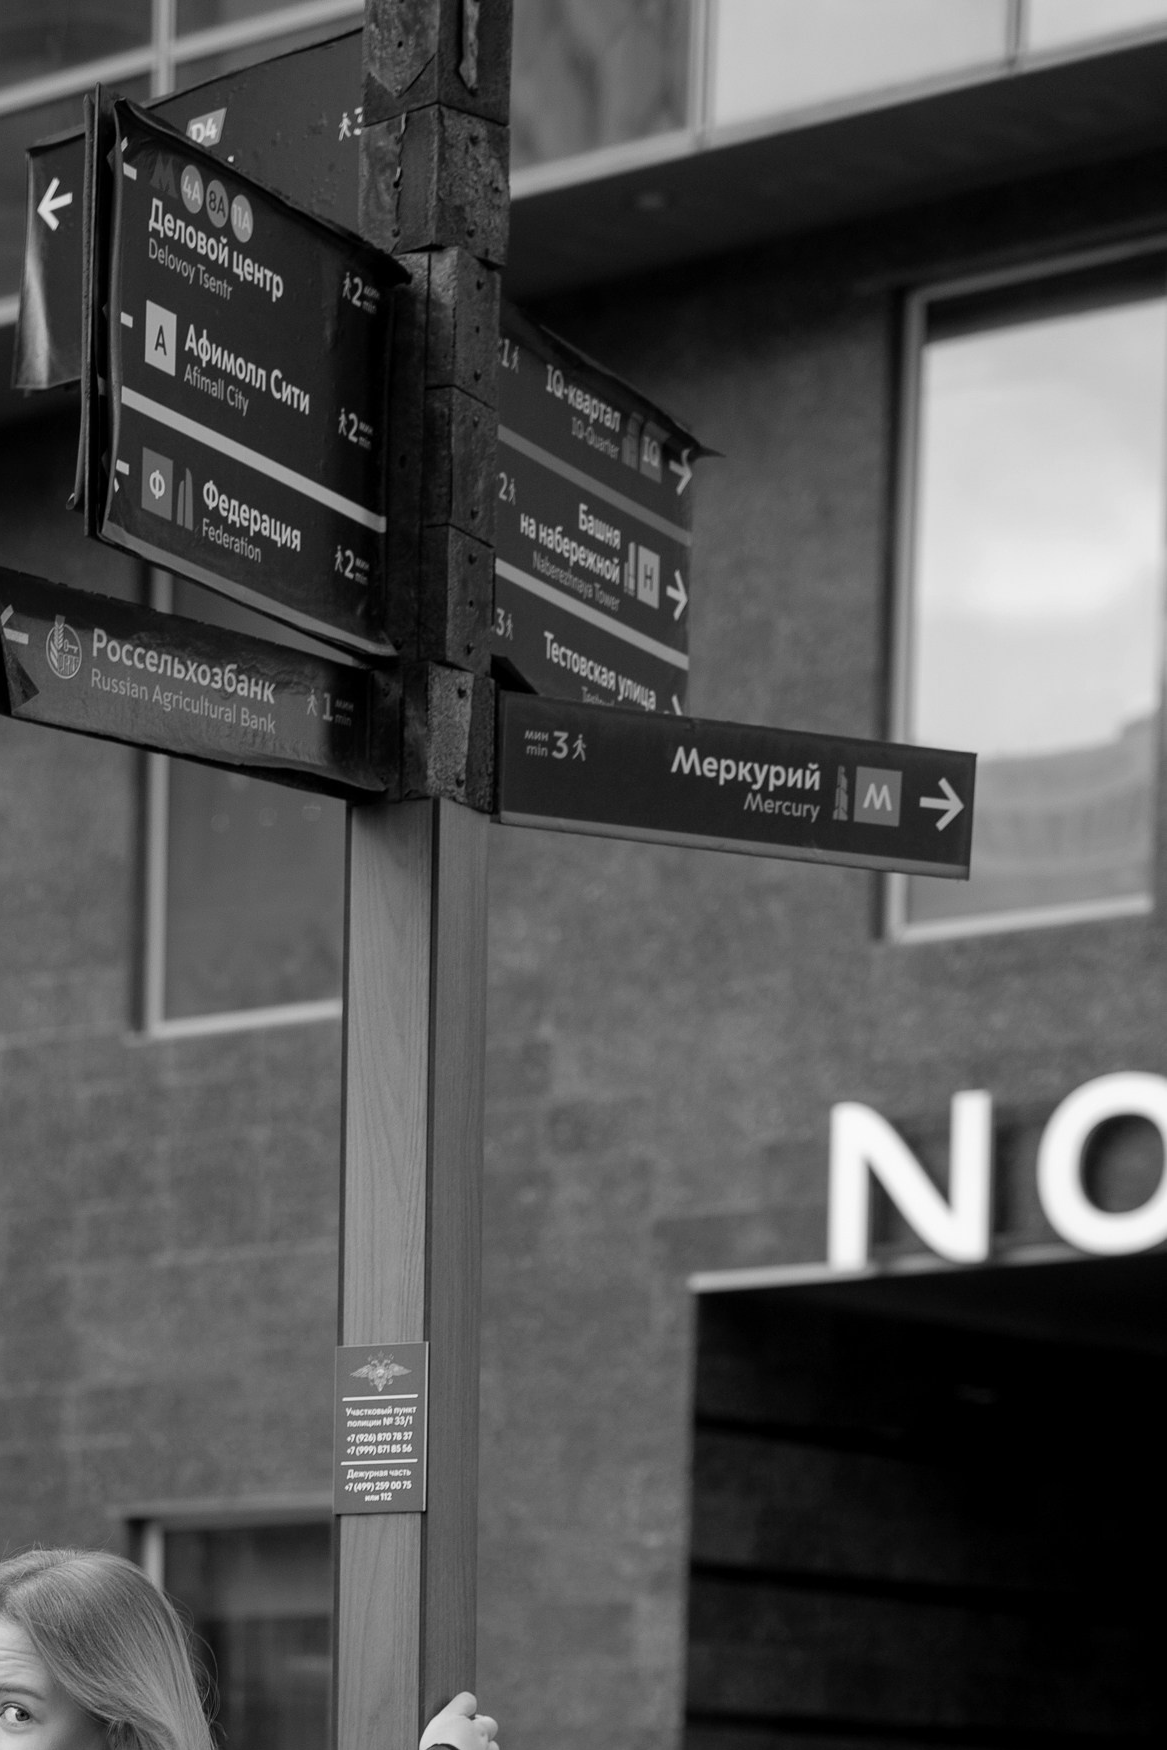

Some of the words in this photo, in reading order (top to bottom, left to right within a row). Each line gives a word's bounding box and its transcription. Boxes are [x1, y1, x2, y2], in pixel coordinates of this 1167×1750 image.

[148, 197, 229, 268] Деловой
[232, 251, 284, 302] центр
[148, 237, 196, 284] Delovoy
[197, 264, 233, 300] Tsentr
[352, 276, 363, 307] 2
[184, 323, 267, 392] Афимолл
[270, 368, 310, 416] Сити
[184, 363, 224, 401] Afimall
[226, 385, 249, 417] City
[545, 363, 621, 432] IQ-квартал
[348, 412, 358, 443] 2
[571, 416, 620, 460] IQ-Quarter
[642, 435, 659, 467] IQ
[149, 469, 165, 499] Ф
[499, 472, 508, 501] 2
[202, 480, 301, 552] Федерация
[578, 502, 621, 550] Башня
[202, 518, 262, 563] Federation
[520, 513, 536, 540] на
[538, 523, 620, 585] набережной
[344, 549, 355, 580] 2
[534, 551, 594, 599] Naberezhnaya
[594, 582, 620, 611] Tower
[496, 607, 505, 636] 3
[92, 627, 276, 704] Россельхозбанк
[544, 630, 616, 691] Тестовская
[617, 674, 656, 711] улица
[91, 667, 148, 701] Russian
[152, 684, 236, 724] Agricultural
[241, 707, 276, 734] Bank
[323, 692, 334, 722] 1
[524, 730, 549, 741] мин
[526, 743, 548, 757] min
[552, 730, 569, 759] 3
[670, 745, 821, 791] Меркурий
[743, 791, 821, 823] Mercury
[345, 1405, 393, 1416] Участковый
[394, 1406, 417, 1416] пункт
[346, 1419, 381, 1427] полиции
[383, 1416, 394, 1426] №
[394, 1415, 413, 1427] 33/1
[346, 1433, 356, 1443] +7
[355, 1432, 376, 1444] (926)
[346, 1445, 356, 1455] +7
[355, 1445, 376, 1456] (999)
[346, 1468, 388, 1480] Дежурная
[389, 1468, 412, 1477] часть
[353, 1481, 374, 1493] (499)
[375, 1480, 390, 1491] 259
[390, 1480, 402, 1490] 00
[364, 1494, 380, 1502] или
[380, 1491, 392, 1501] 112
